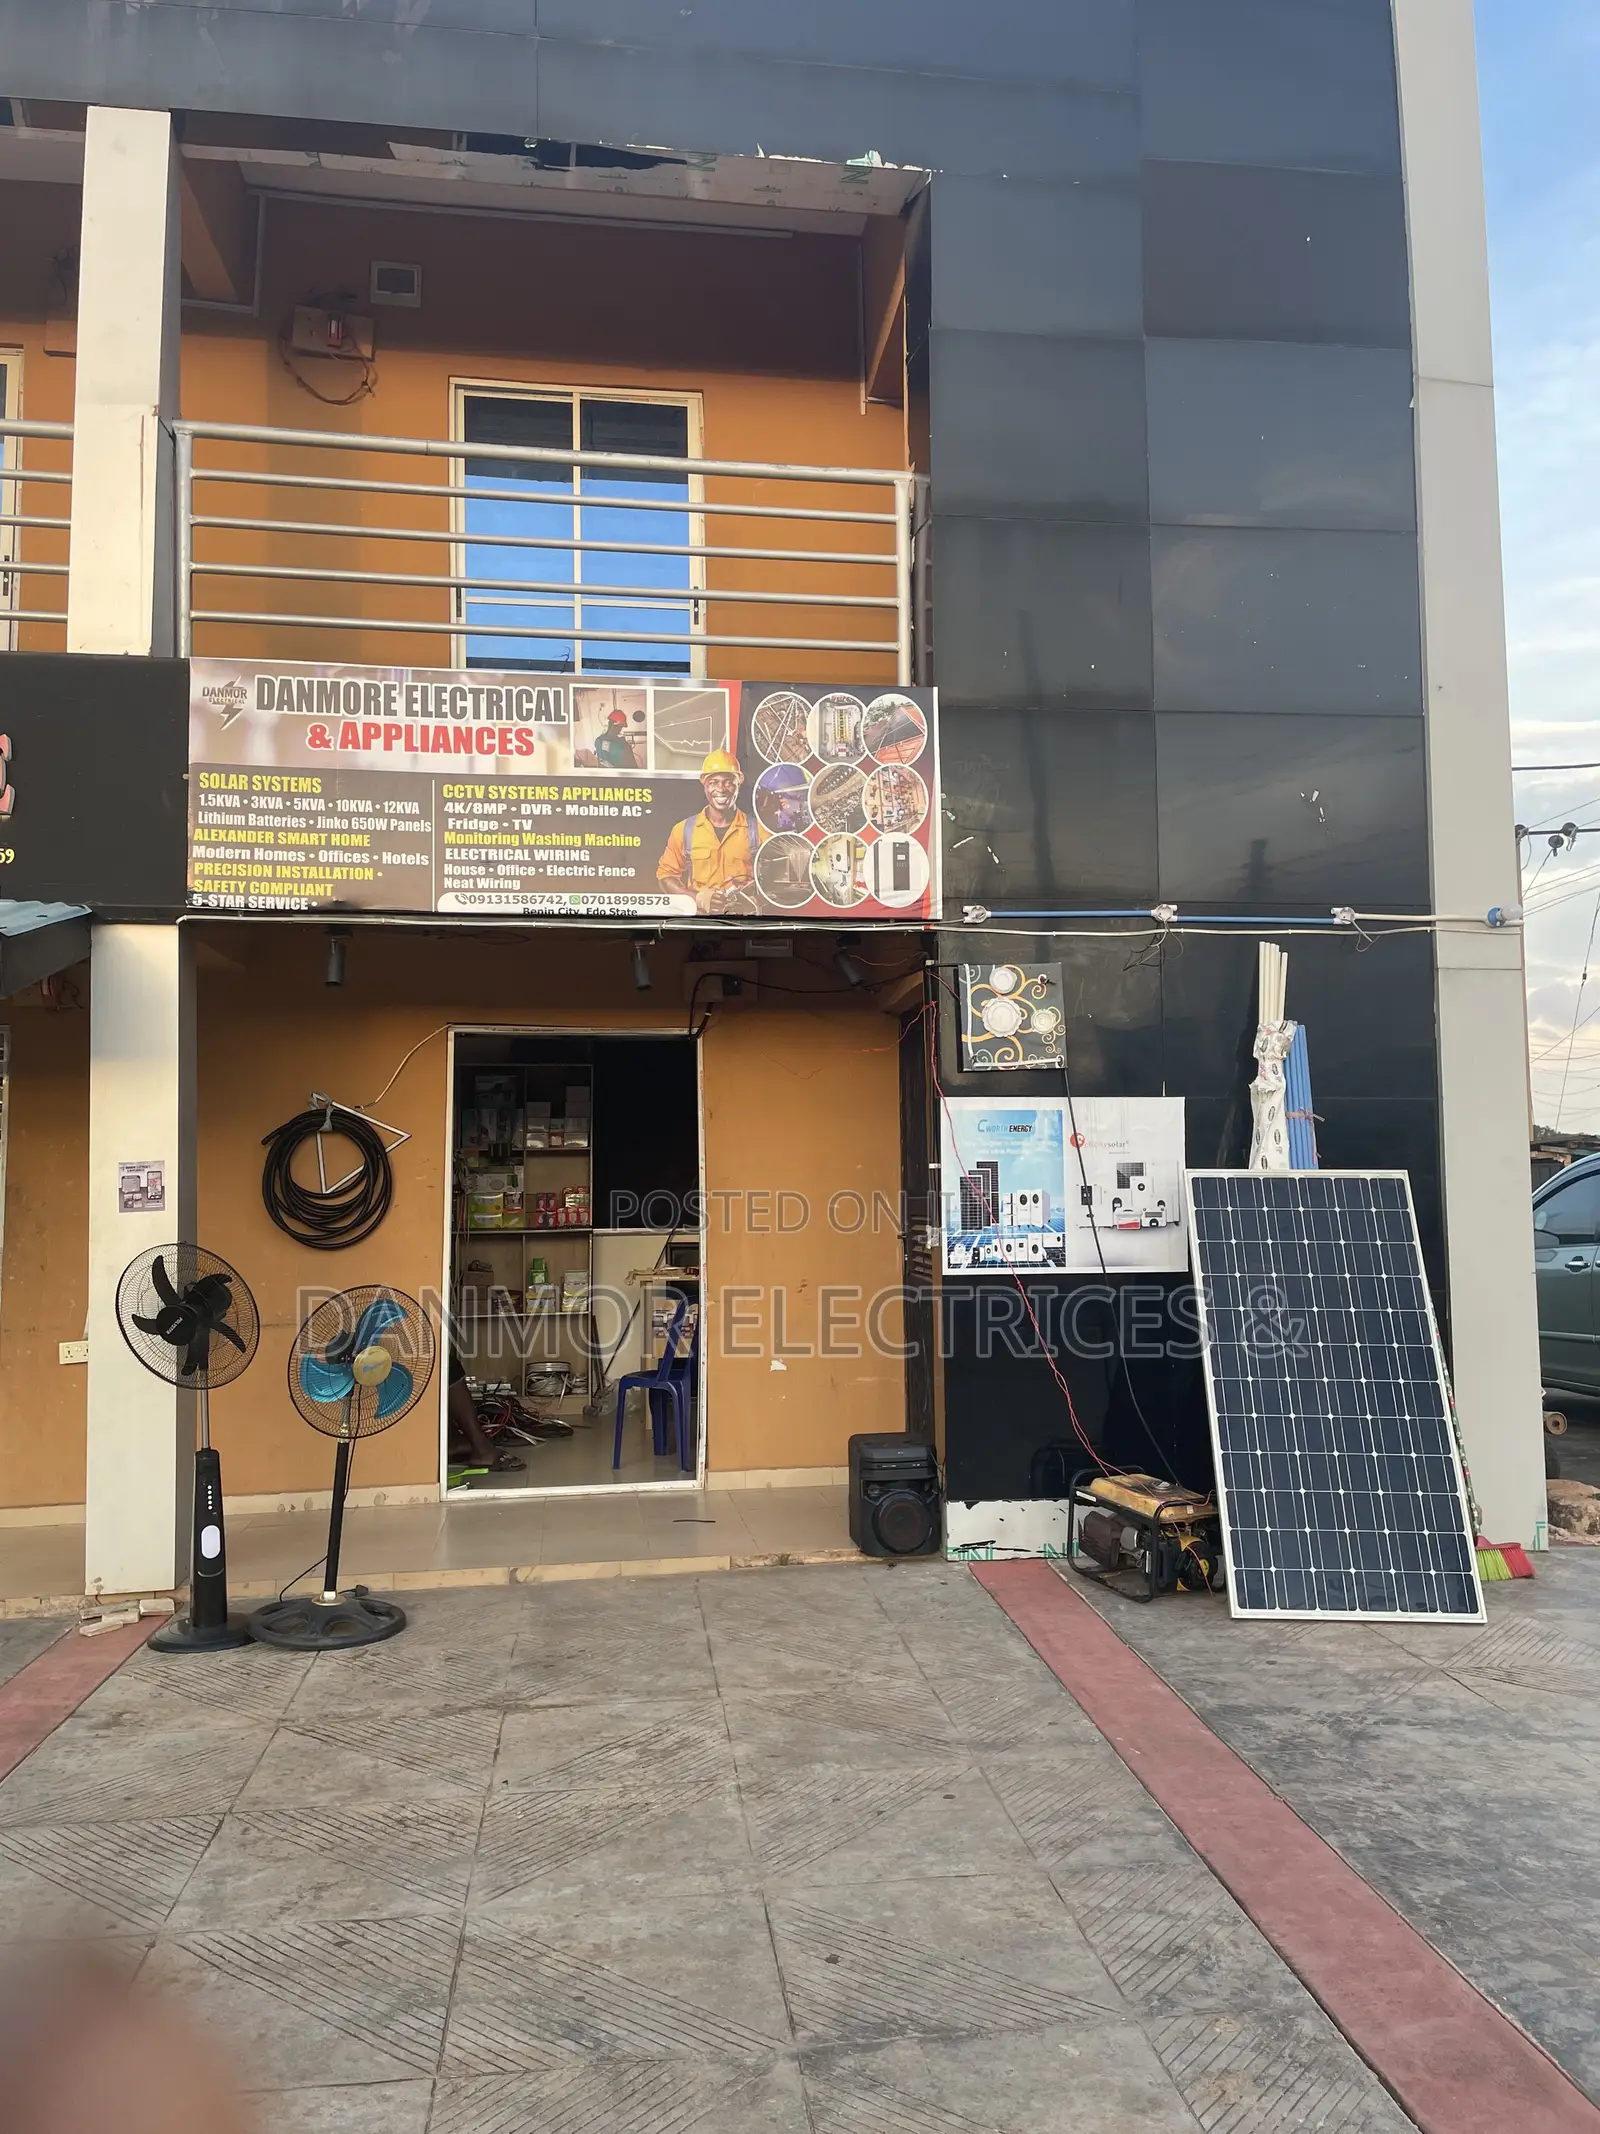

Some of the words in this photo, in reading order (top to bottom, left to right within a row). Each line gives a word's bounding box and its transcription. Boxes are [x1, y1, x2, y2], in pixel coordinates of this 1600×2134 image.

[203, 687, 247, 699] DANMOR
[256, 677, 398, 717] DANMORE
[405, 684, 567, 722] ELECTRICAL
[308, 724, 332, 750] &
[339, 721, 534, 756] APPLIANCES
[199, 772, 249, 790] SOLAR
[252, 774, 322, 793] SYSTEMS
[443, 784, 485, 799] CCTV
[488, 785, 559, 800] SYSTEMS
[562, 786, 653, 802] APPLIANCES
[199, 793, 241, 808] 1.5KVA
[251, 796, 284, 809] 3KVA
[294, 798, 325, 811] 5KVA
[336, 799, 373, 813] 10KVA
[383, 801, 420, 815] 12KVA
[444, 802, 507, 815] 4K/8MP
[521, 803, 552, 815] DVR
[565, 804, 619, 816] Mobile
[621, 805, 642, 817] AC
[198, 811, 245, 826] Lithium
[248, 813, 306, 828] Batteries
[316, 816, 349, 829] Jinko
[351, 817, 387, 831] 650W
[390, 818, 432, 832] Panels
[448, 818, 499, 831] Fridge
[512, 819, 533, 831] TV
[194, 828, 274, 844] ALEXANDER
[278, 832, 328, 846] SMART
[330, 833, 370, 847] HOME
[444, 831, 520, 847] Monitoring
[522, 833, 582, 847] Washing
[584, 833, 641, 847] Machine
[193, 845, 251, 860] Modern
[254, 847, 306, 862] Homes
[318, 849, 370, 864] Offices
[382, 851, 429, 865] Hotels
[445, 848, 531, 861] ELECTRICAL
[534, 849, 590, 861] WIRING
[194, 862, 273, 878] PRECISION
[276, 865, 374, 881] INSTALLATION
[444, 863, 486, 876] House
[497, 864, 536, 876] Office
[546, 864, 596, 877] Electric
[598, 866, 636, 877] Fence
[194, 879, 246, 894] SAFETY
[249, 881, 334, 897] COMPLIANT
[444, 878, 475, 889] Neat
[477, 878, 520, 890] Wiring
[193, 893, 245, 908] 5-STAR
[248, 896, 308, 910] SERVICE
[468, 894, 567, 906] 09131586742,
[581, 896, 670, 906] 07018998578
[523, 907, 555, 915] Benin
[586, 908, 606, 916] Edo
[609, 908, 638, 917] State
